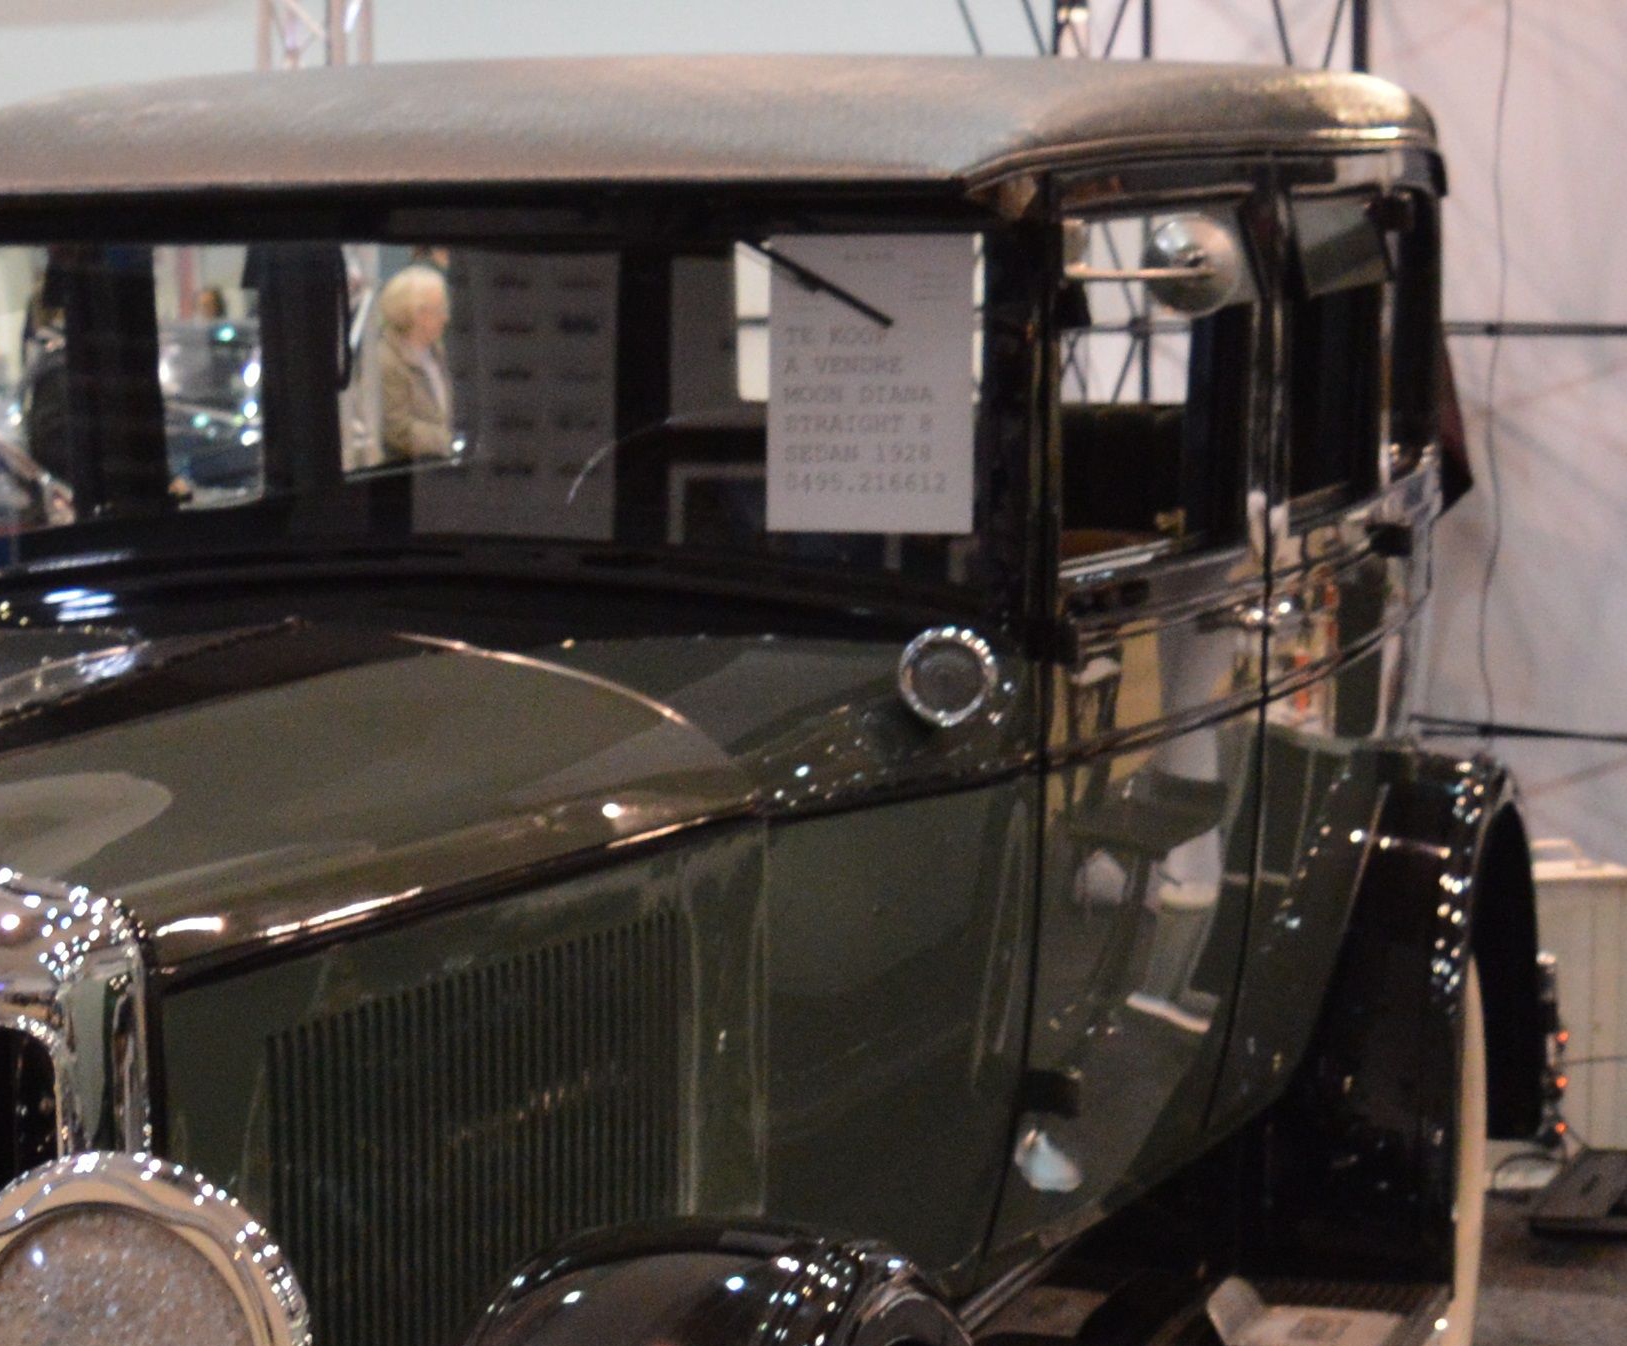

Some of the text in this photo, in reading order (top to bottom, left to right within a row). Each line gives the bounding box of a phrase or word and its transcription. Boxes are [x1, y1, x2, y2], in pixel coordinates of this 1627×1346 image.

[814, 355, 904, 374] VENDRE
[783, 386, 934, 404] MOON DIANA
[784, 414, 905, 434] STRAIGHT
[784, 444, 859, 463] SEDAN
